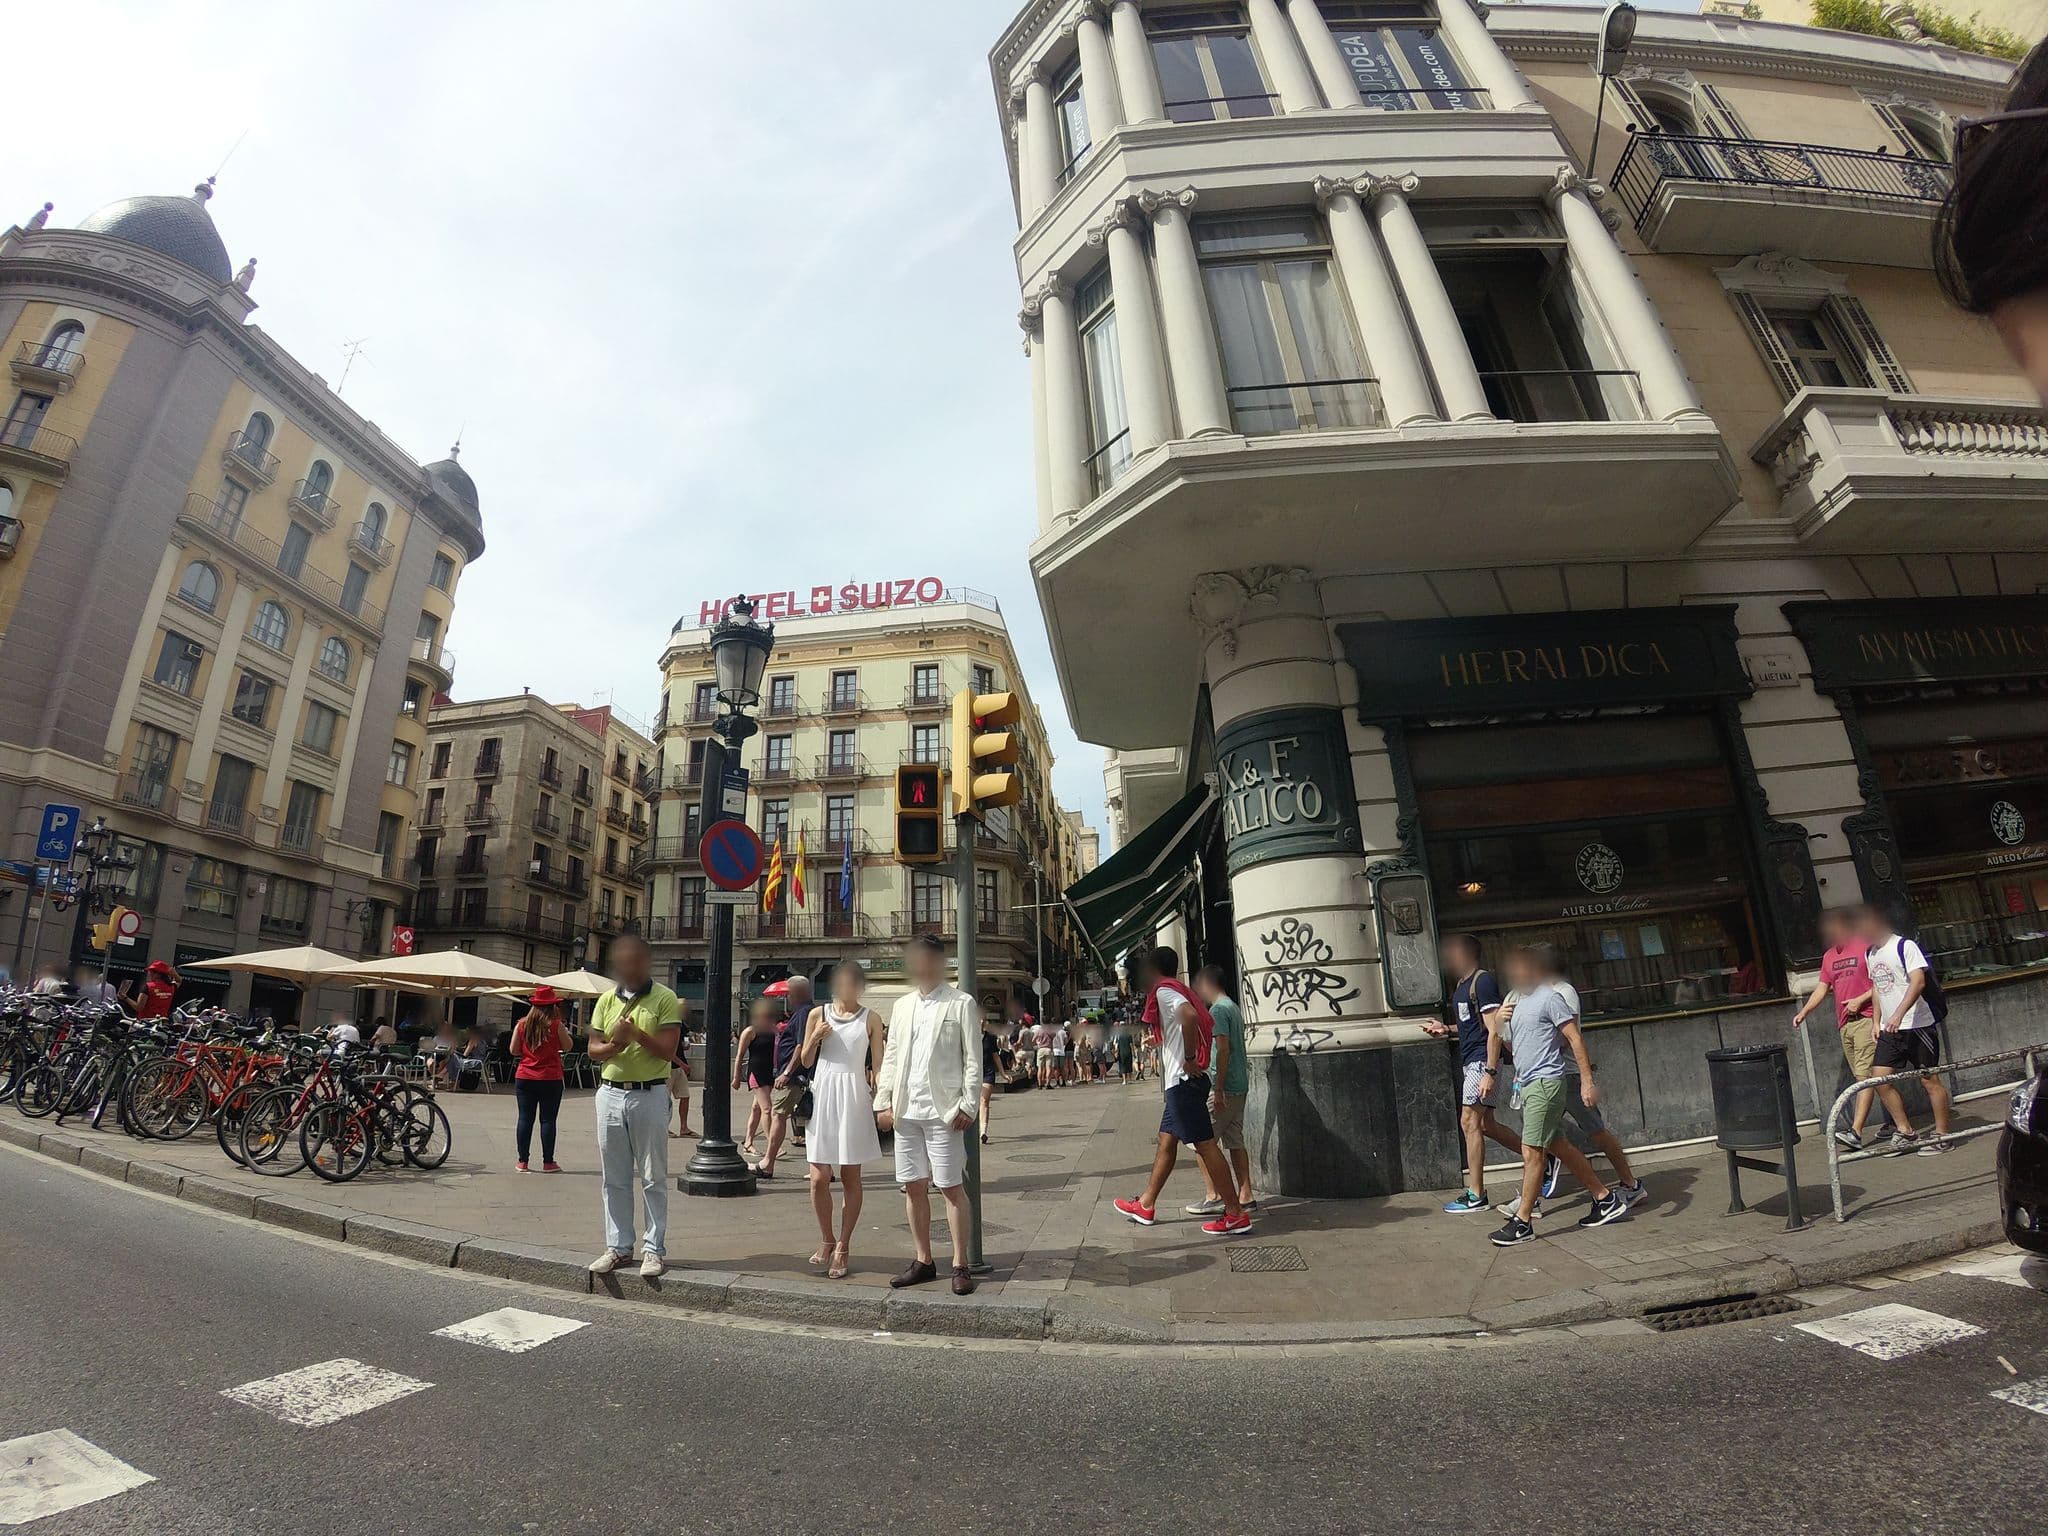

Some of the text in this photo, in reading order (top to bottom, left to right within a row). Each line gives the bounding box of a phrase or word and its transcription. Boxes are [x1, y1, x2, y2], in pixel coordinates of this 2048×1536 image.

[700, 591, 805, 624] HOTEL
[840, 577, 943, 610] SUIZO
[1858, 626, 2048, 663] NVMISMATIC
[1440, 643, 1671, 687] HERALDICA
[50, 812, 69, 832] P
